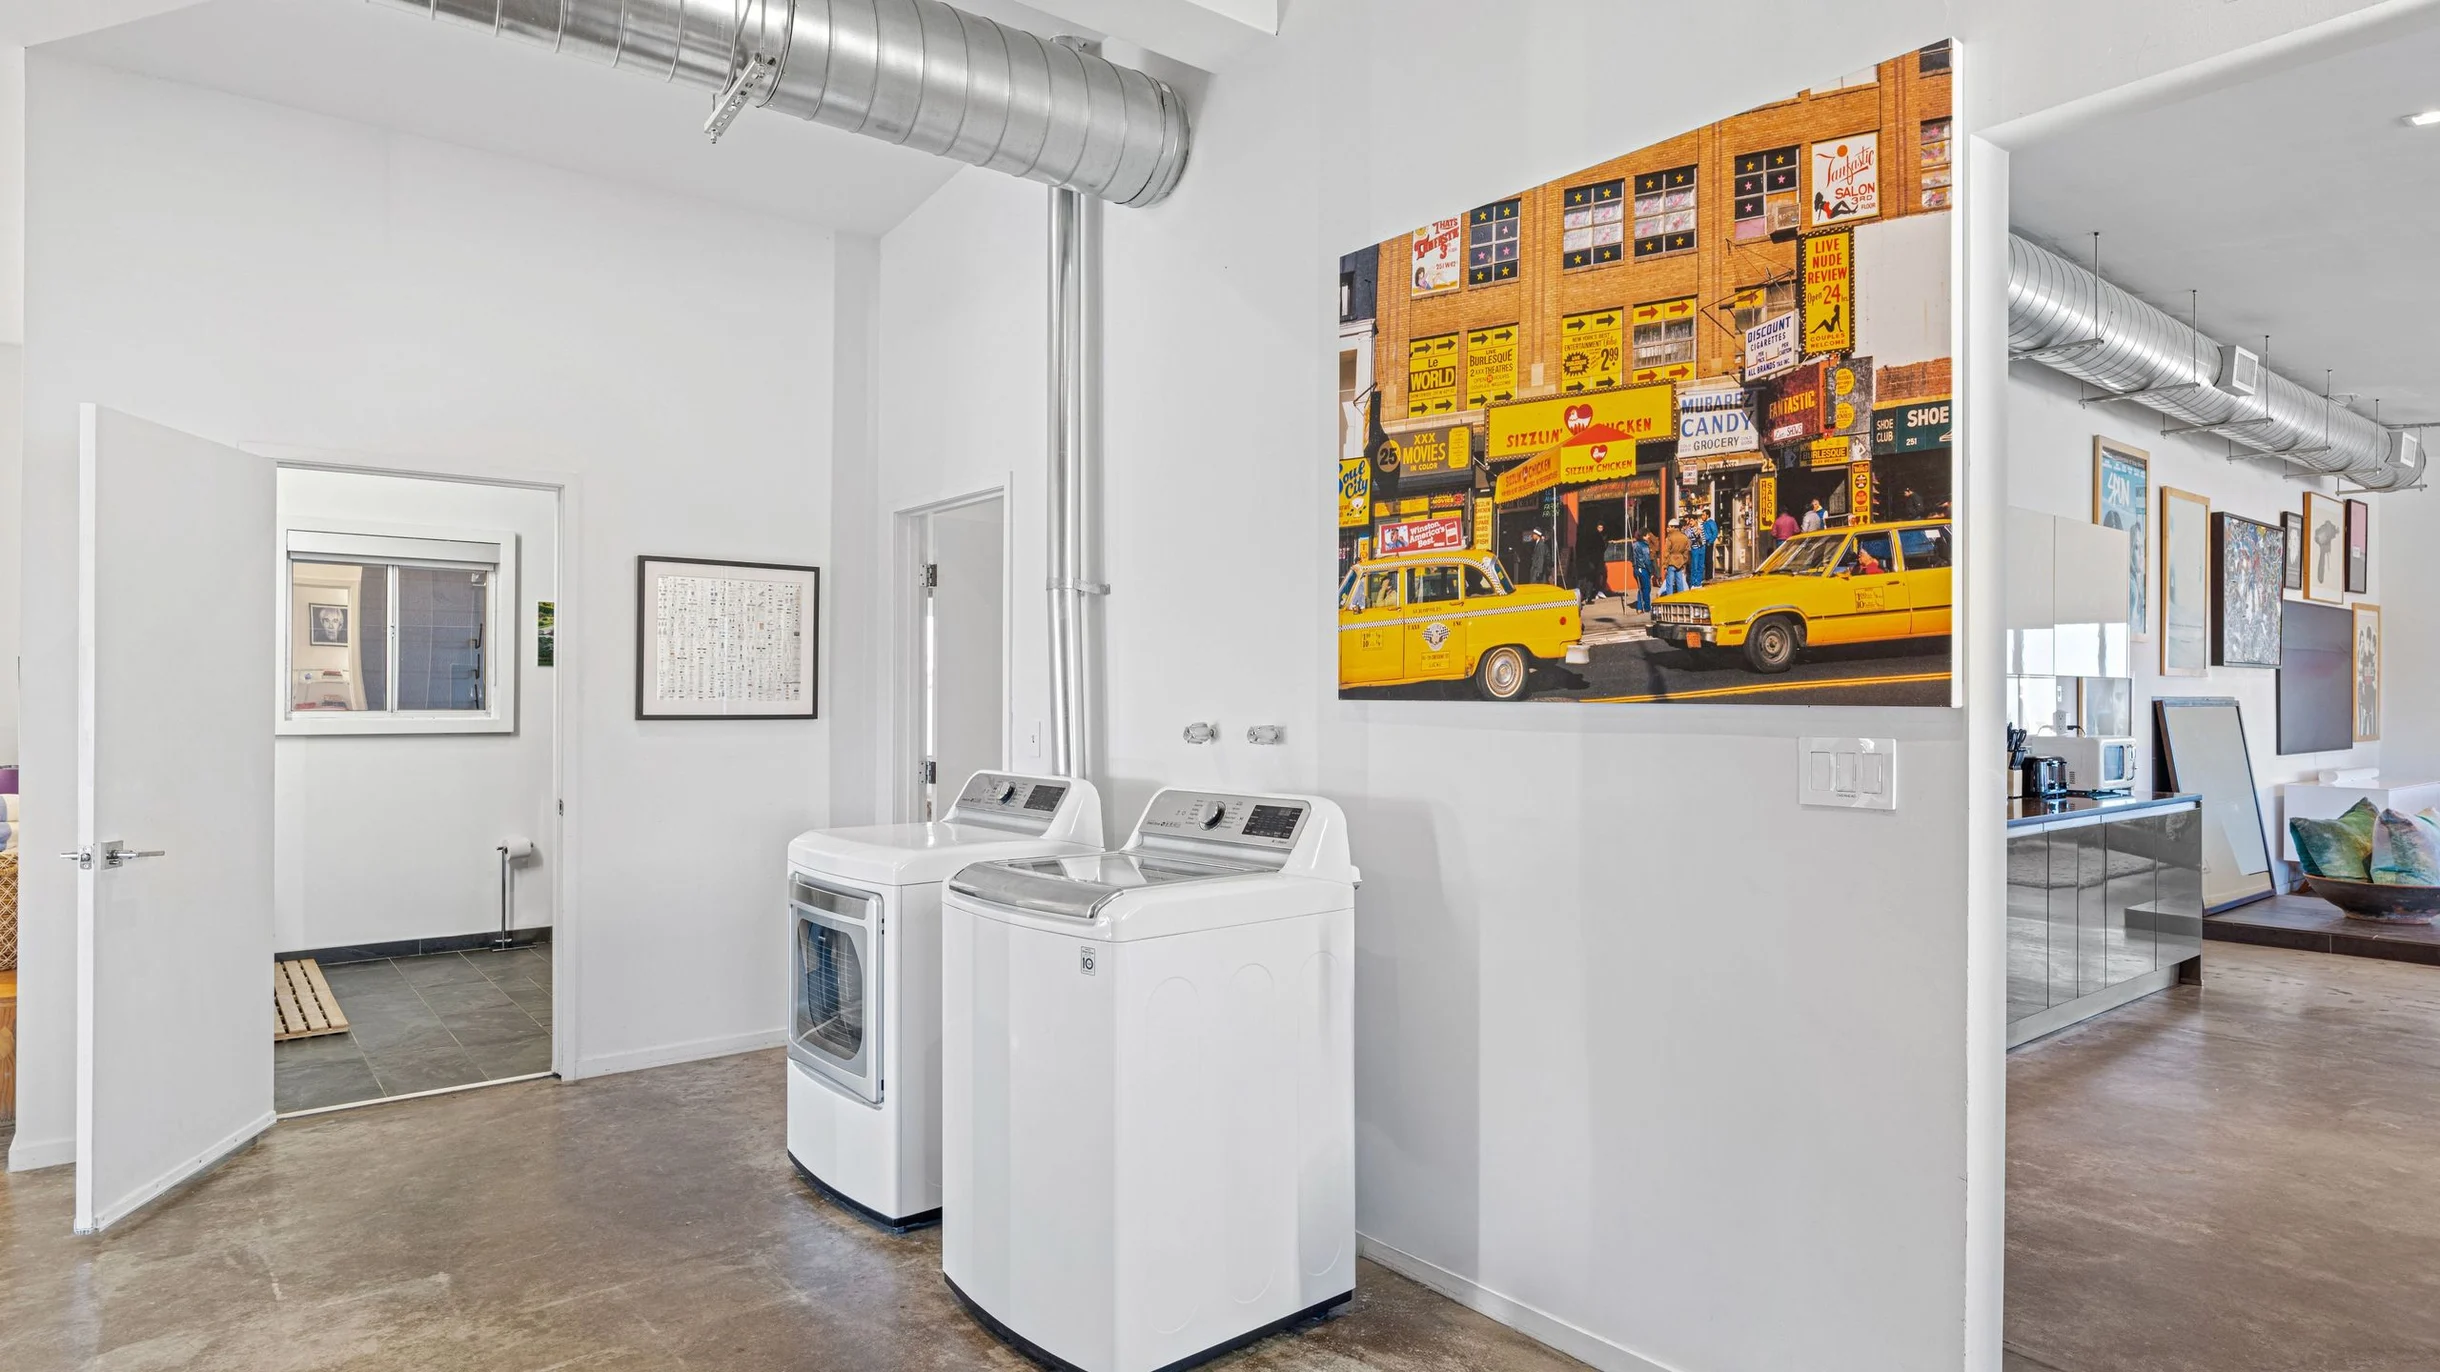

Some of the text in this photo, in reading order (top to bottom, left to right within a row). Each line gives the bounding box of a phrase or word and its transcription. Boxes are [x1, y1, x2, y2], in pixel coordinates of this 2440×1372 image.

[1816, 146, 1875, 188] Tanfastic
[1835, 182, 1875, 199] SALON
[1851, 195, 1873, 205] 3RD
[1815, 238, 1839, 254] LIVE
[1812, 253, 1842, 274] NUDE
[1807, 267, 1847, 284] REVIEW
[1823, 284, 1840, 305] 24
[1748, 316, 1791, 343] DISCOUNT
[1810, 333, 1845, 342] COUPLES
[1751, 332, 1786, 351] CIGARETTES
[1811, 340, 1845, 349] WELCOME
[1428, 359, 1438, 368] Le
[1470, 349, 1512, 366] BURLESQUE
[1485, 363, 1513, 374] THEATRES
[1748, 367, 1756, 377] ALL
[1757, 361, 1776, 374] BRANDS
[1411, 368, 1454, 391] WORLD
[1681, 391, 1754, 414] MUBAREZ
[1769, 391, 1816, 419] FANTASTIC
[1681, 411, 1754, 437] CANDY
[1876, 418, 1893, 430] SHOE
[1907, 406, 1949, 427] SHOE
[1414, 433, 1436, 445] XXX
[1507, 428, 1563, 448] SIZZLIN'
[1693, 436, 1739, 451] GROCERY
[1876, 431, 1893, 443] CLUB
[1906, 438, 1917, 446] 251
[1380, 448, 1398, 465] 25
[1403, 442, 1446, 464] MOVIES
[1420, 463, 1437, 471] COLOR
[1597, 460, 1632, 472] CHICKEN
[1345, 478, 1368, 499] City
[1409, 525, 1446, 543] America's
